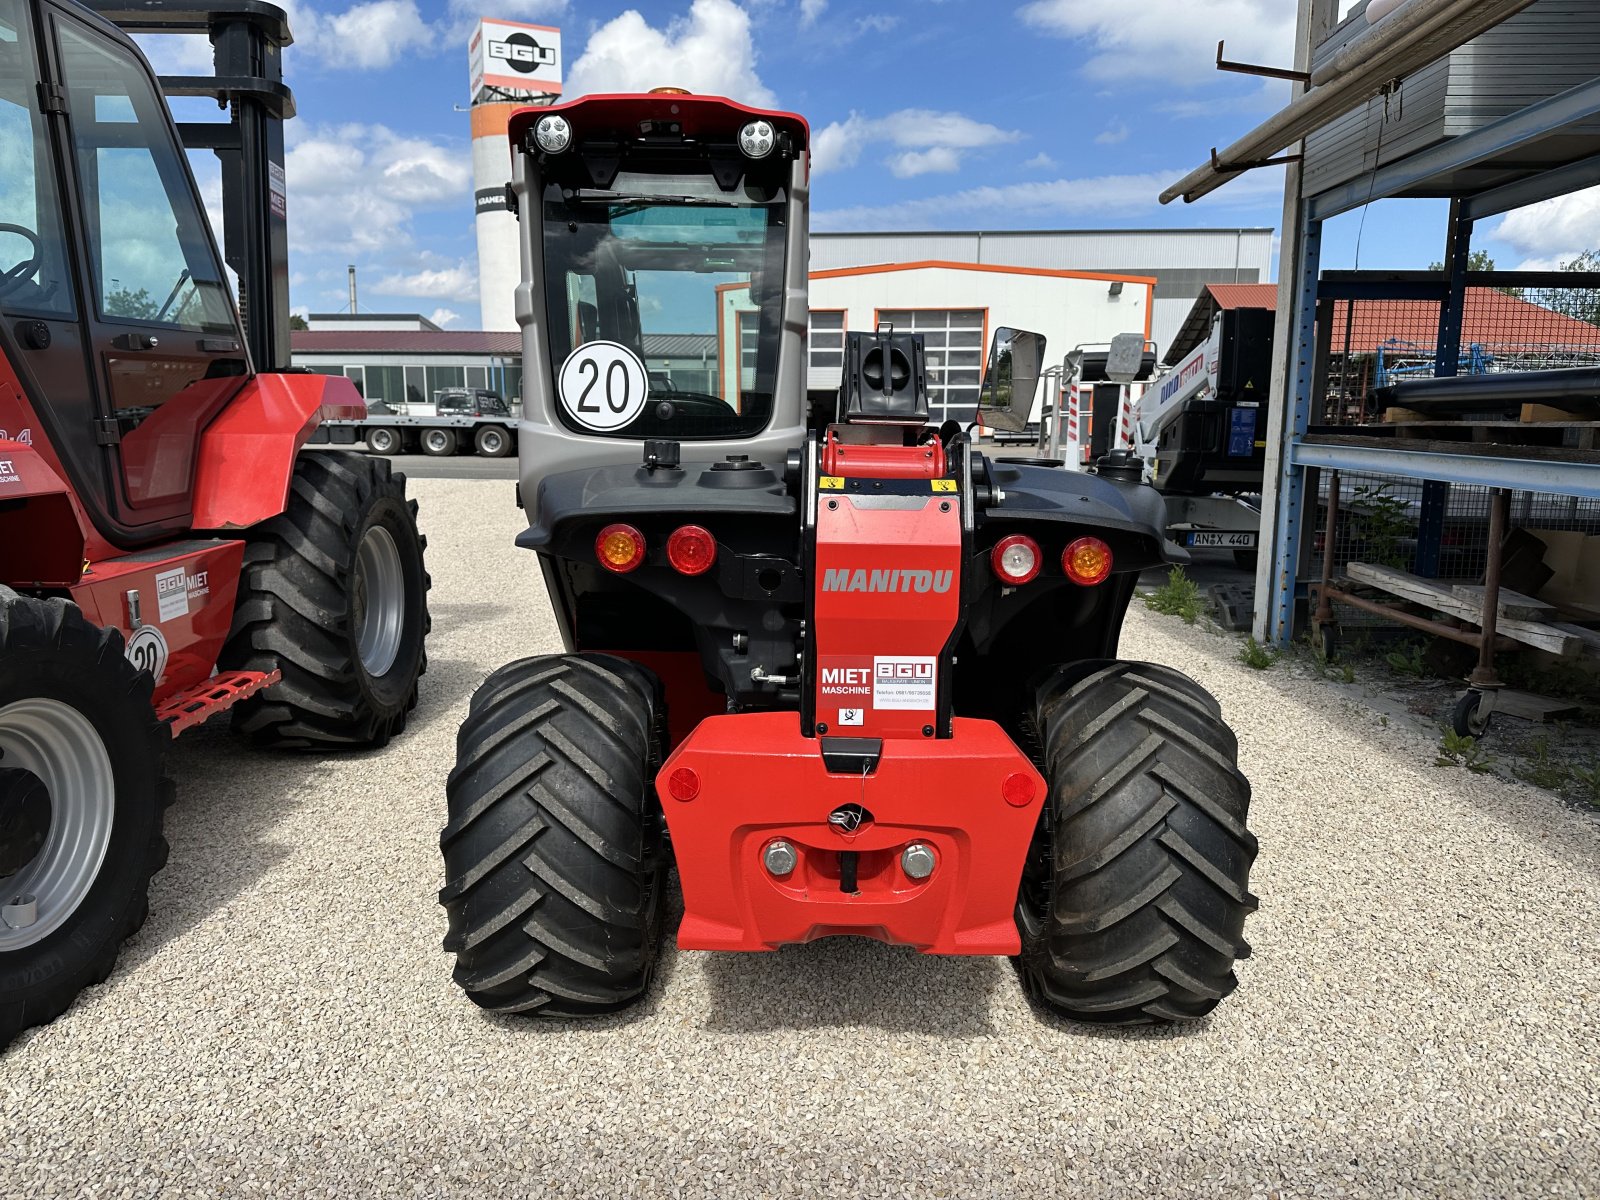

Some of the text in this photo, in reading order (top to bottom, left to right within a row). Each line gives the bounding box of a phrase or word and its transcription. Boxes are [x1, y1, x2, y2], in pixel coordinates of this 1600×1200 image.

[489, 40, 556, 65] BGU
[577, 358, 629, 413] 20
[1195, 533, 1210, 545] AN
[1228, 534, 1250, 545] 440
[158, 573, 185, 593] BGU
[186, 571, 208, 591] MIET
[822, 568, 954, 593] MANITOU
[821, 668, 871, 684] MIET
[876, 662, 933, 678] BGU
[821, 686, 871, 695] MASCHINE
